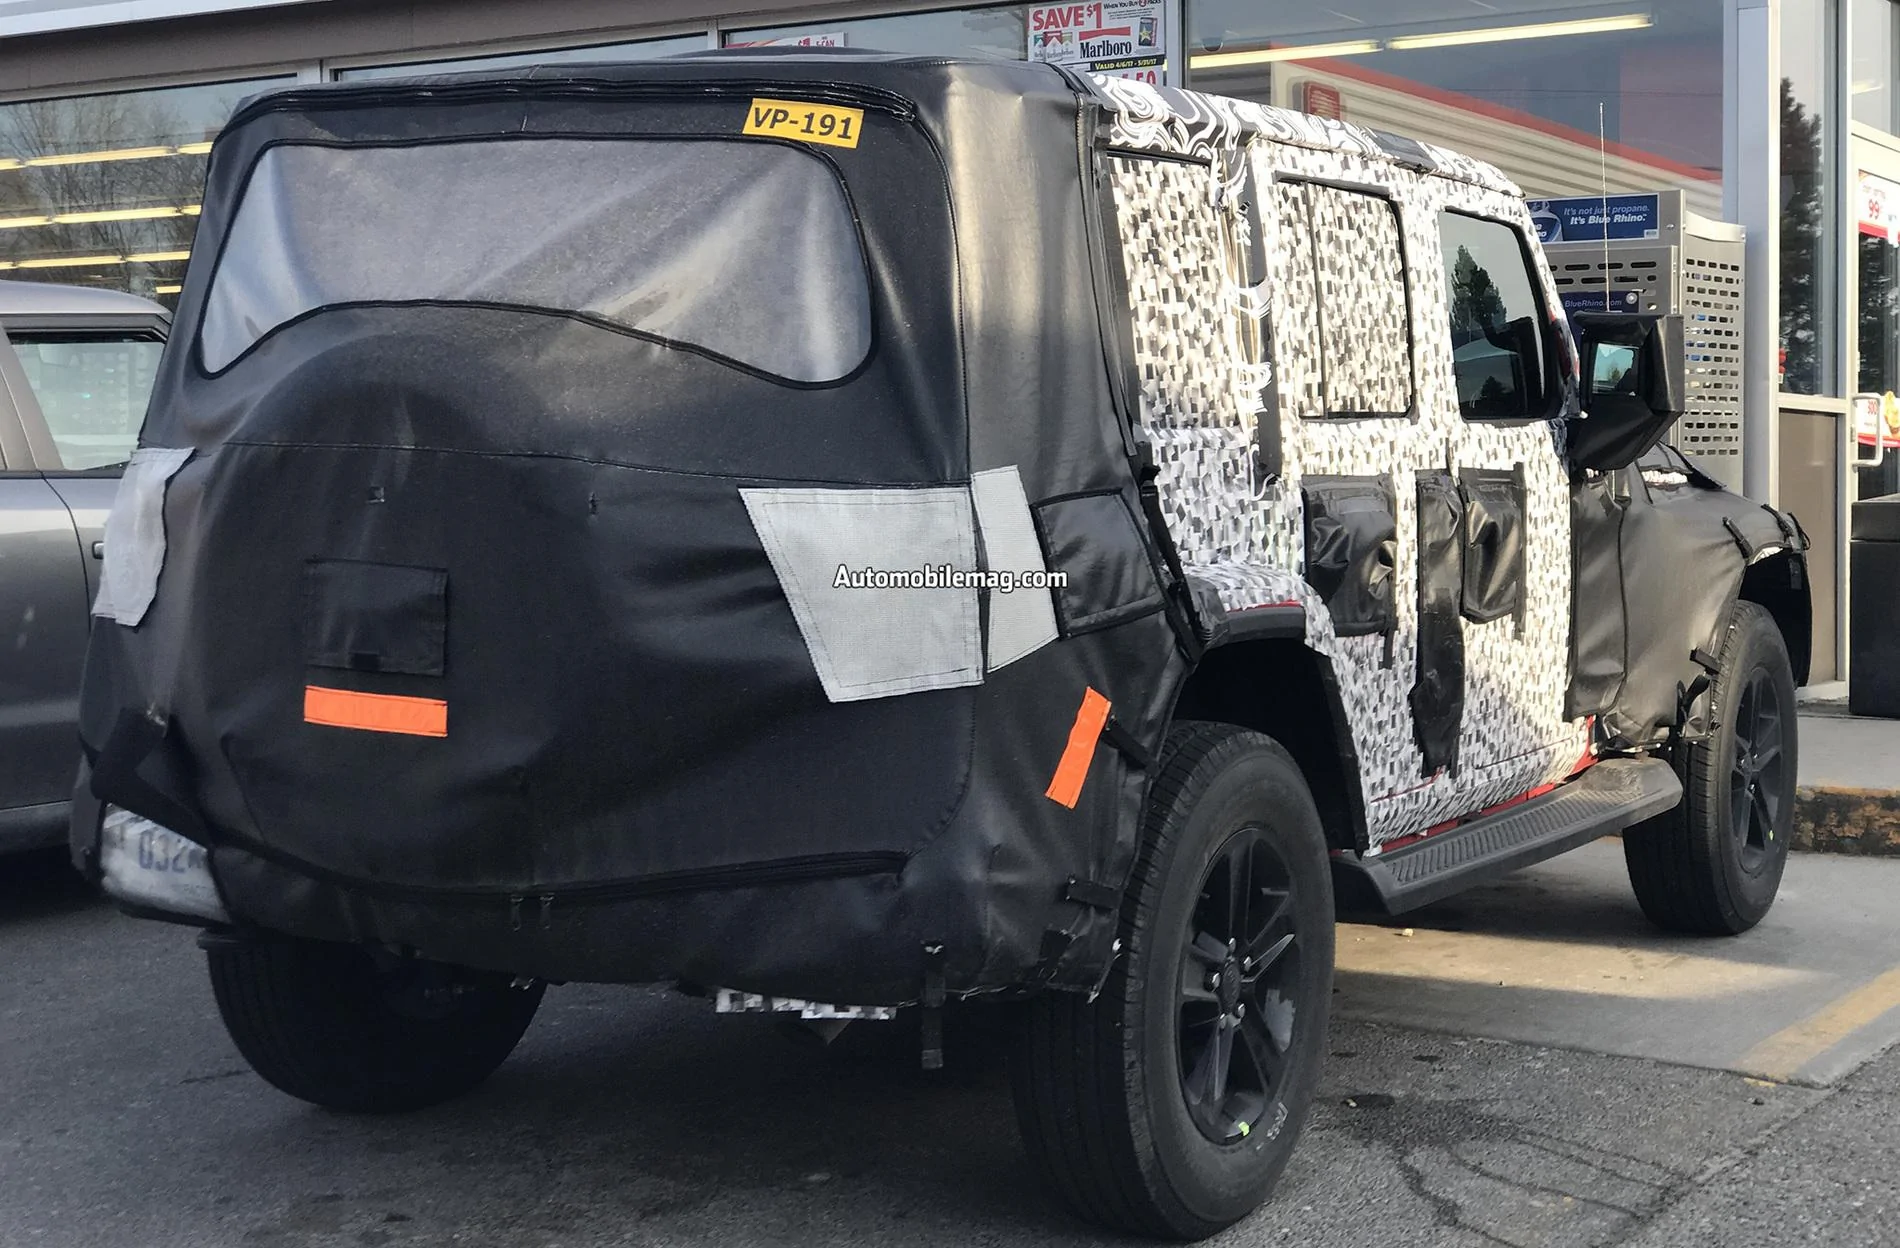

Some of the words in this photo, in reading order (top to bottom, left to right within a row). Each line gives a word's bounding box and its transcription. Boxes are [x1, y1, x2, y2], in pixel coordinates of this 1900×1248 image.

[1033, 5, 1084, 31] SAVE
[1086, 2, 1102, 28] $1
[1079, 40, 1132, 59] Marlboro
[754, 107, 852, 140] VP-191
[1564, 207, 1576, 216] It's
[1612, 205, 1650, 214] propane.
[1570, 216, 1586, 225] It's
[1564, 300, 1622, 308] BlueRhino.om
